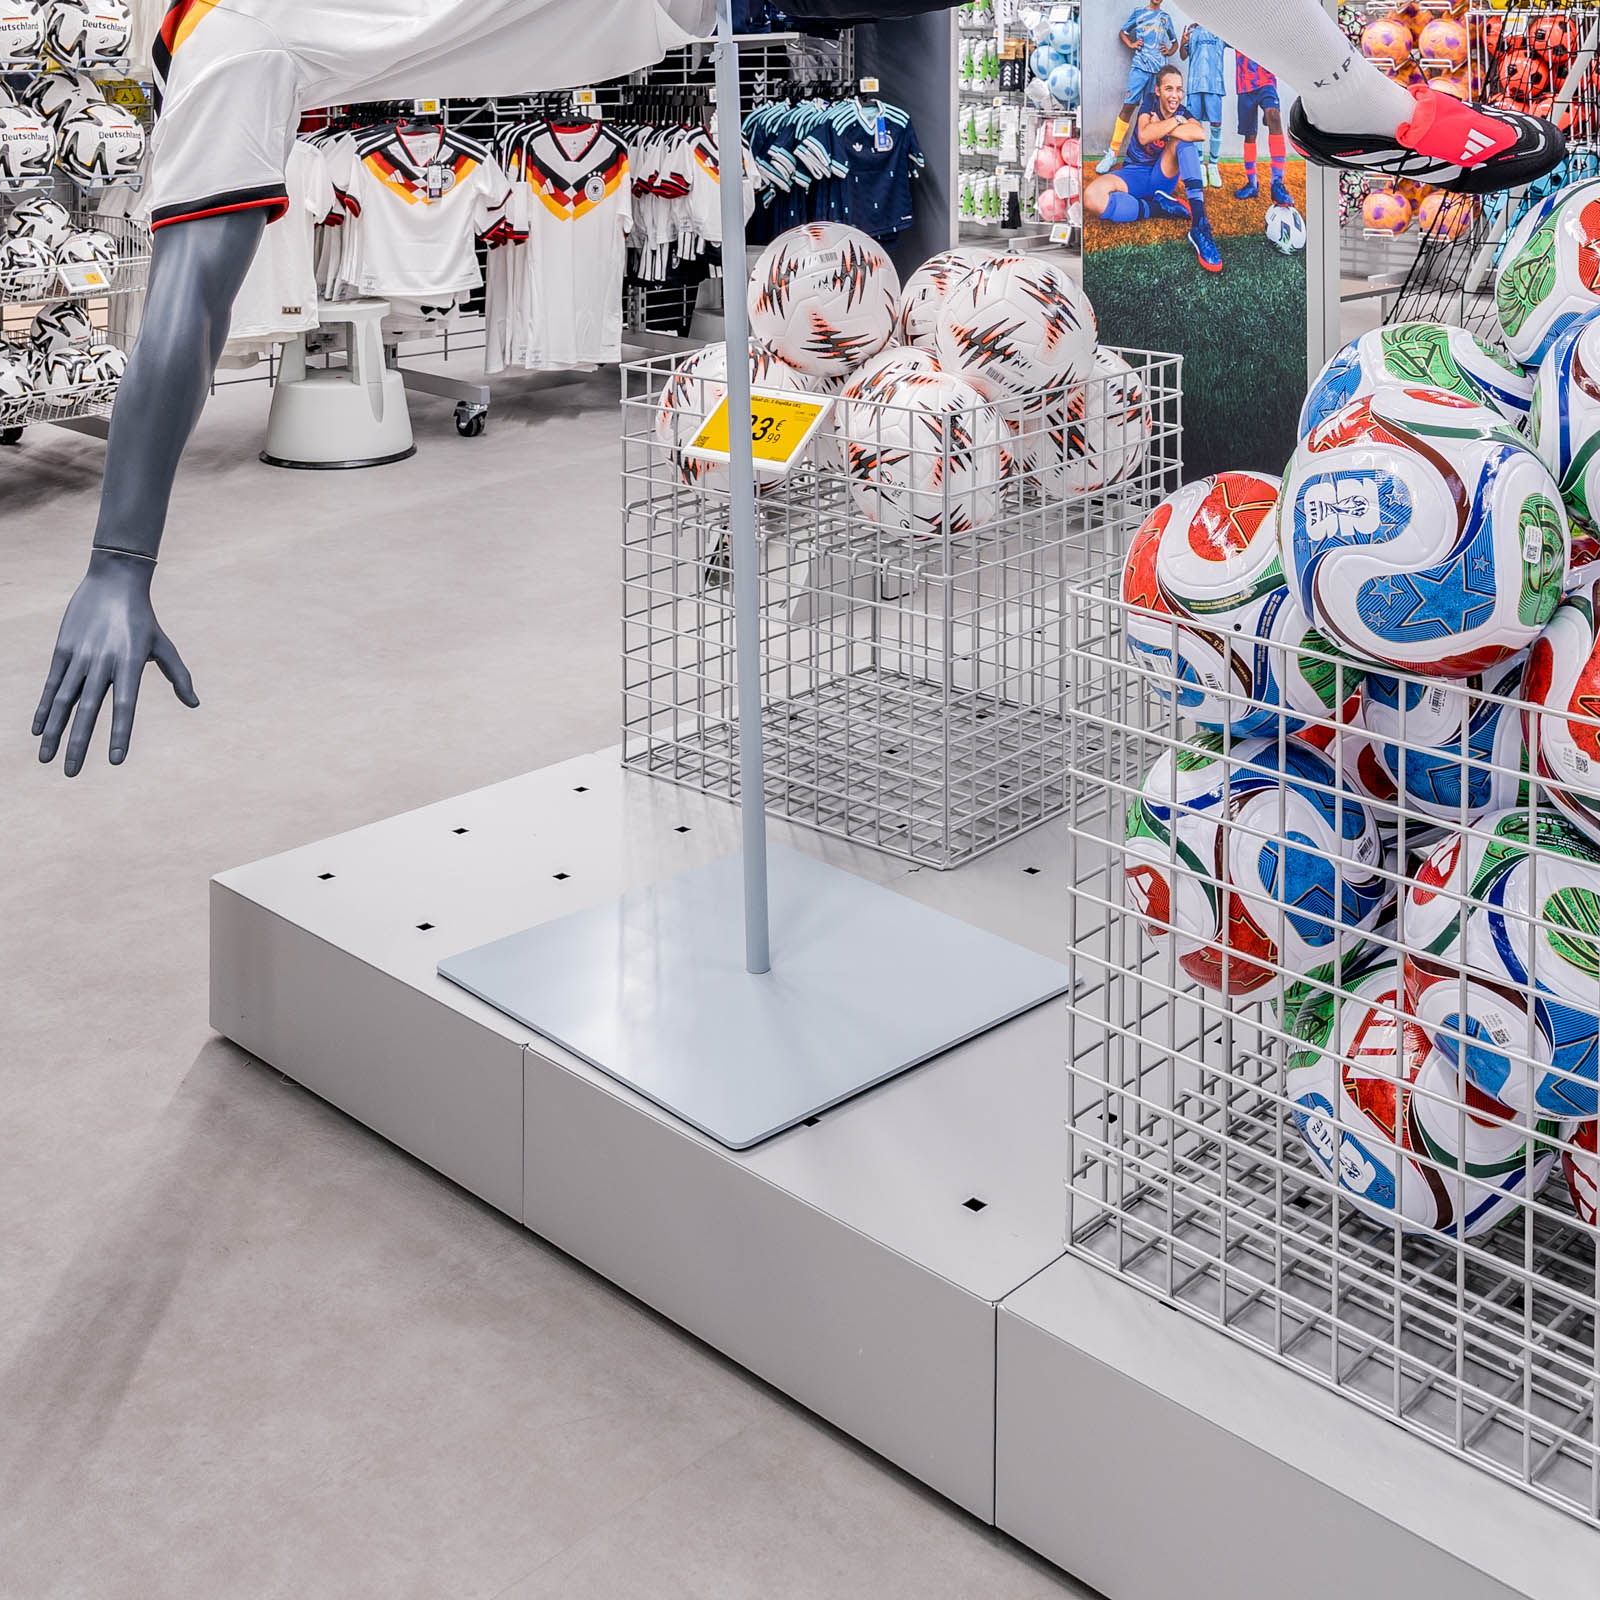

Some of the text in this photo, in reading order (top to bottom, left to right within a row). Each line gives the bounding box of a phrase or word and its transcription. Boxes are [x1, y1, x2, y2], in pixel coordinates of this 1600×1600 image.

[82, 19, 127, 33] Deutschland
[1, 132, 49, 142] Deutschland
[99, 131, 141, 140] Deutschland
[766, 433, 781, 443] 99
[1309, 501, 1317, 527] FIFA
